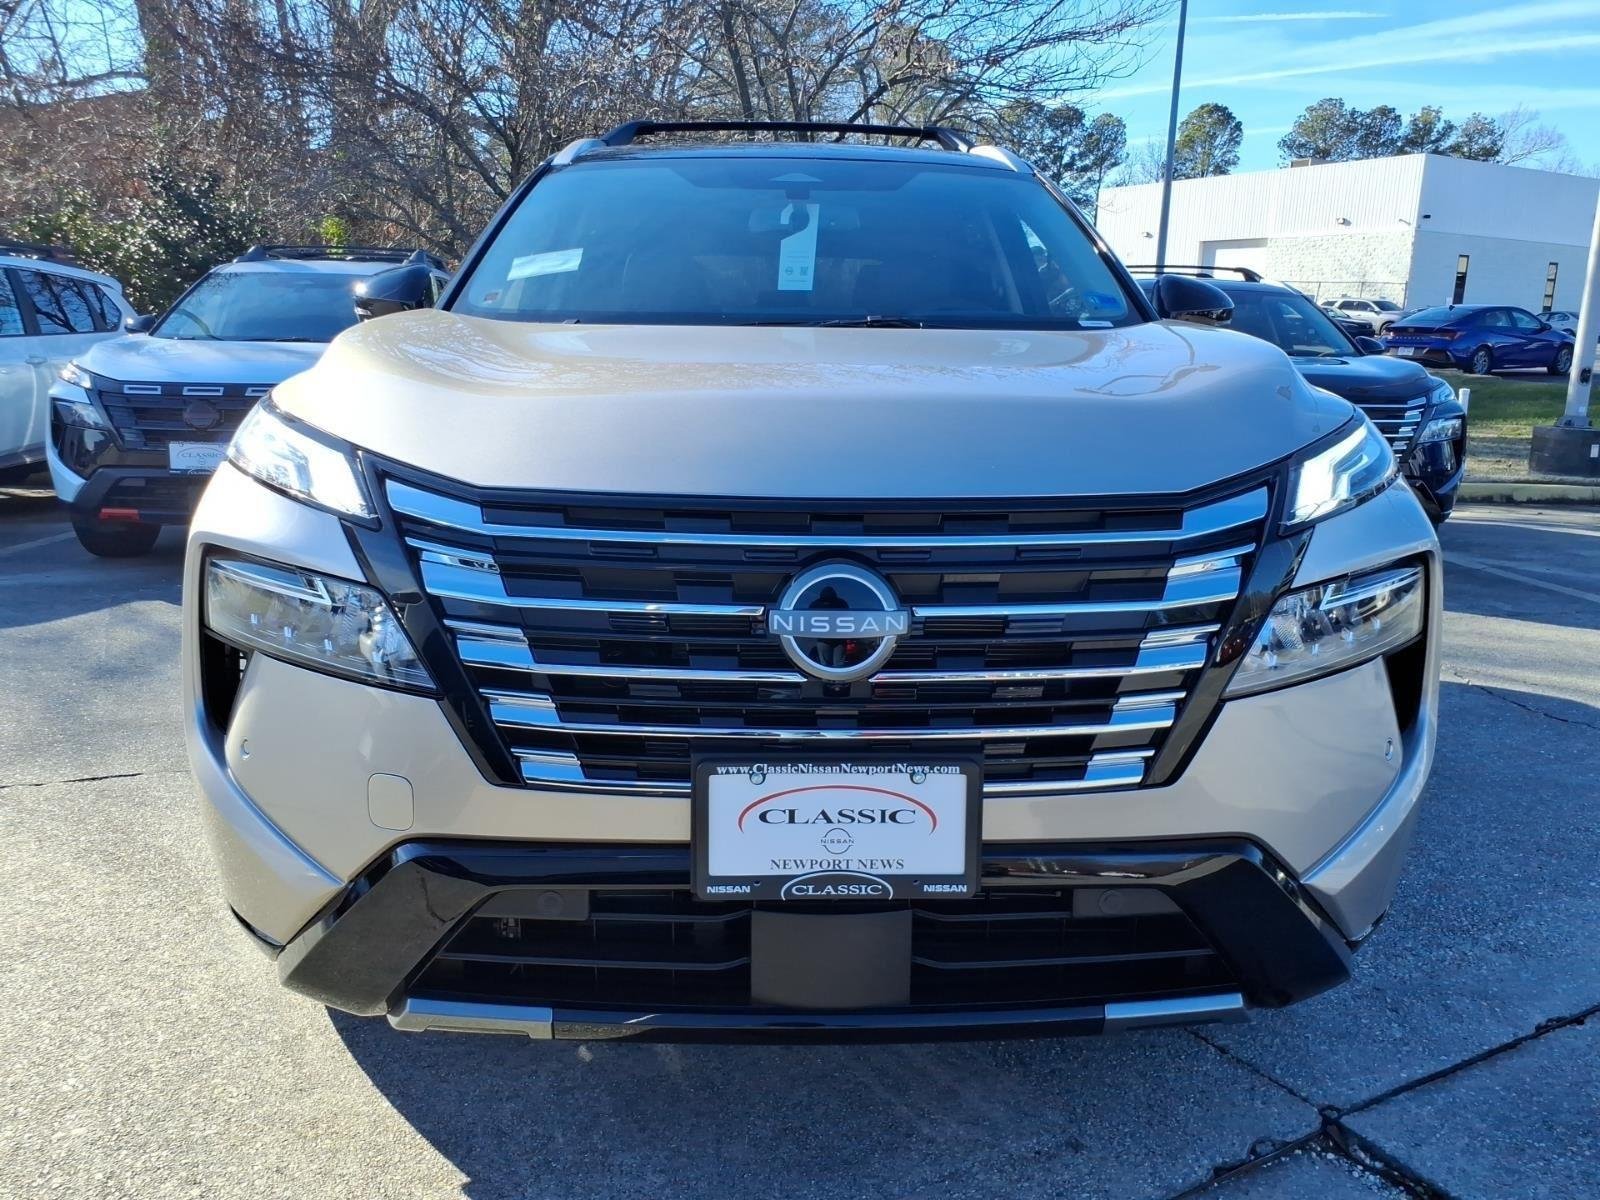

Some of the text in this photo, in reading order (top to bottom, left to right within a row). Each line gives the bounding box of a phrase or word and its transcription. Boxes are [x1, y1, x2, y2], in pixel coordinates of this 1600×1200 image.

[773, 615, 904, 632] NISSAN
[716, 763, 961, 776] www.ClassicNissanNewportNews.com
[758, 808, 916, 824] CLASSIC
[770, 859, 905, 870] NEWPORT NEWS
[706, 885, 751, 894] NISSAN
[791, 884, 883, 896] CLASSIC
[923, 884, 967, 893] NISSAN
